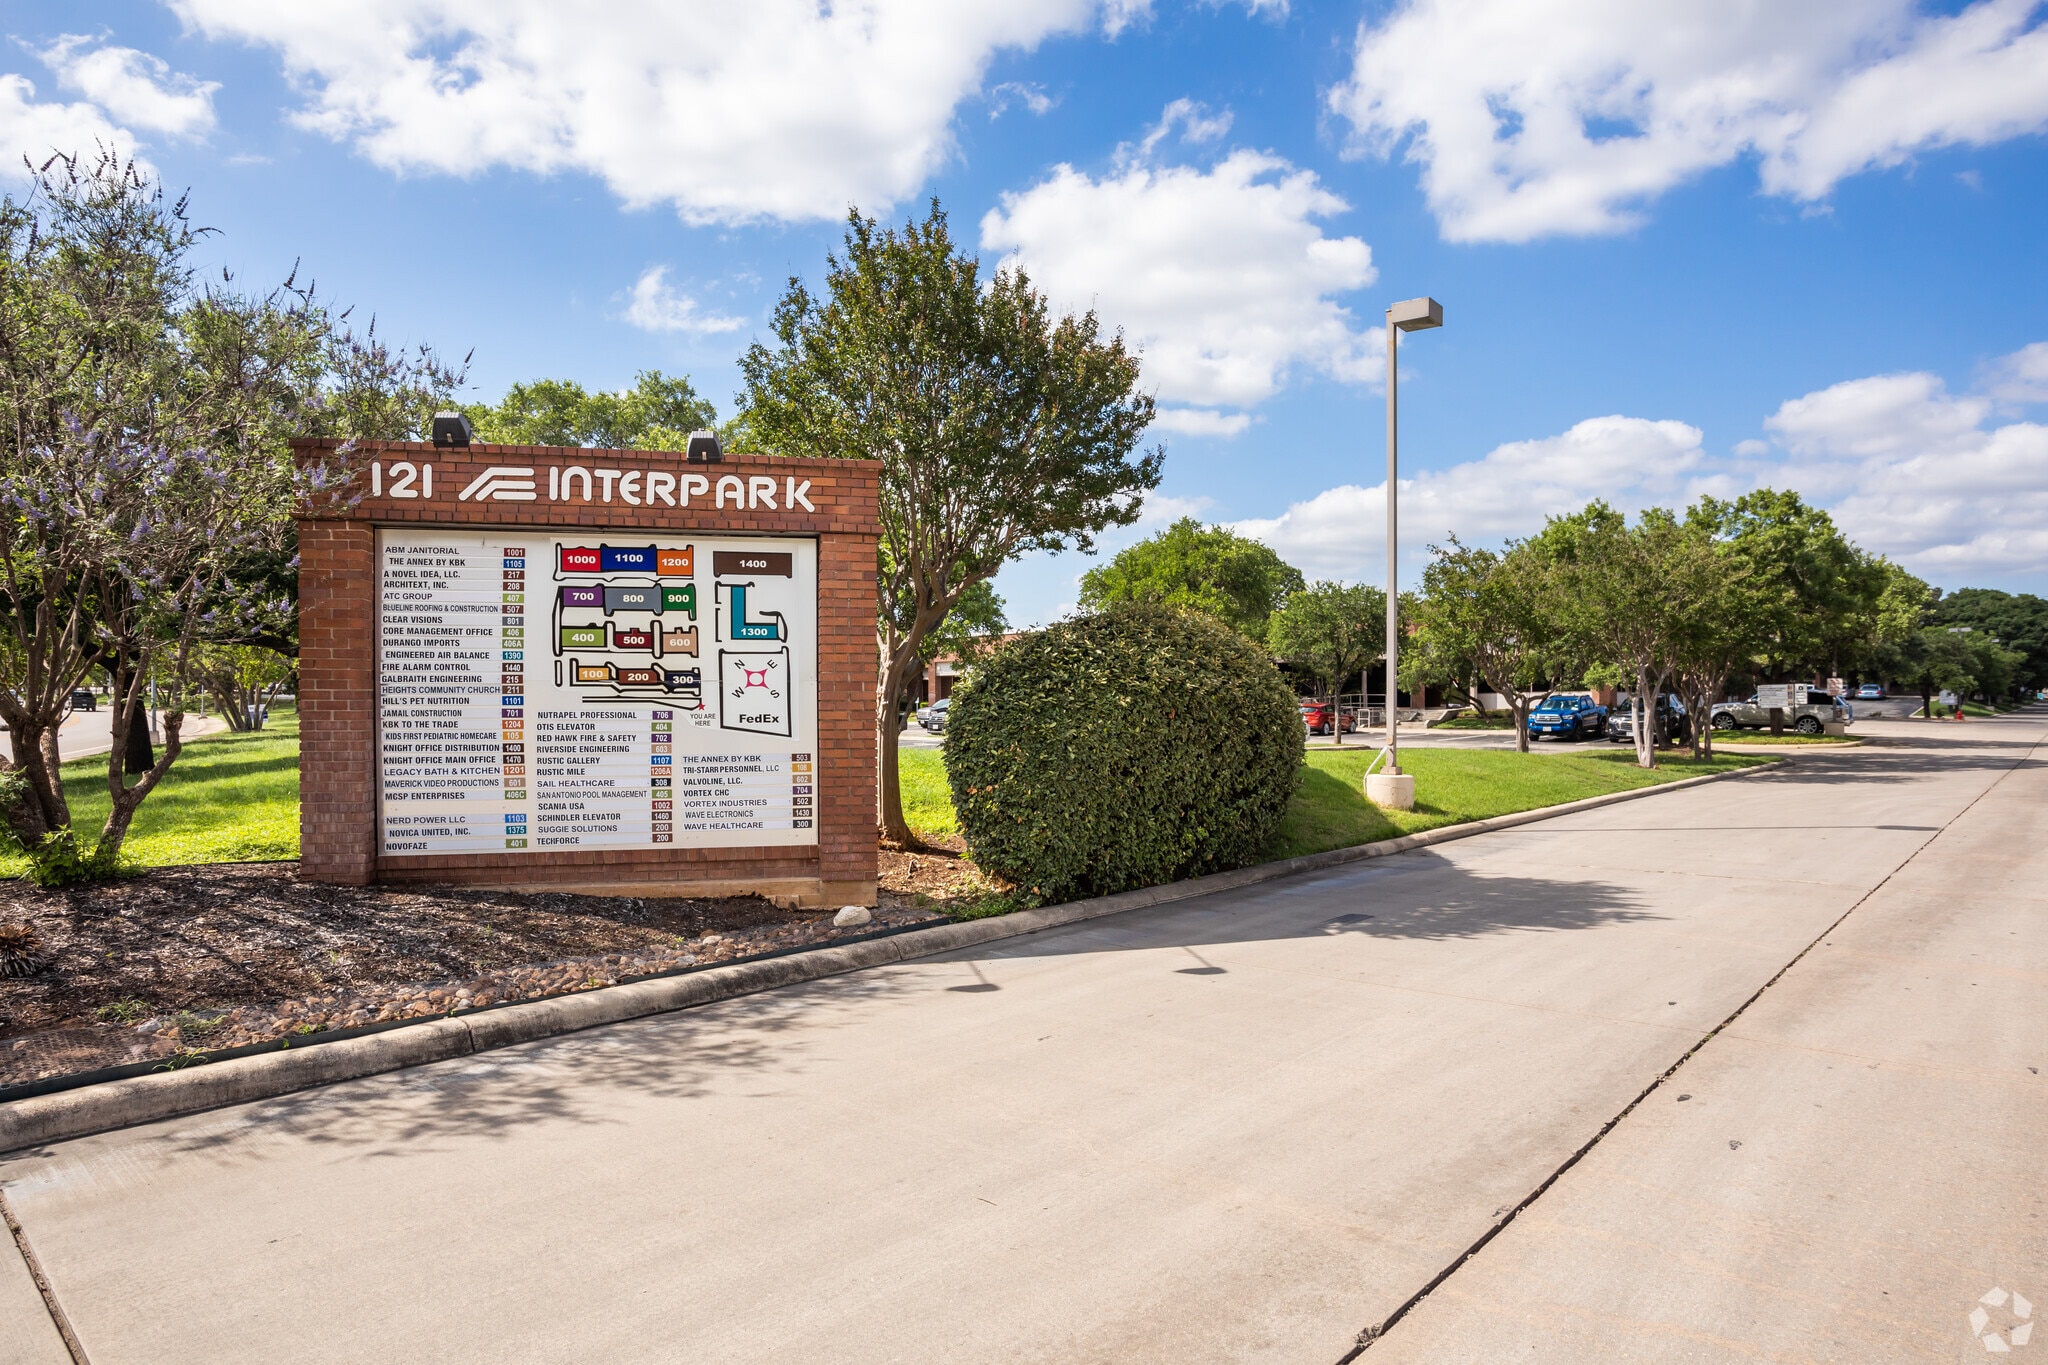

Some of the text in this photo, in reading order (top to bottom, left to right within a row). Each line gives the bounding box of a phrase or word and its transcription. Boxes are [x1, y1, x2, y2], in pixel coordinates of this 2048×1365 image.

[372, 462, 815, 512] 121 INTERPARK
[567, 555, 596, 564] 1000
[615, 554, 643, 562] 1100
[662, 558, 689, 566] 1200
[740, 560, 767, 568] 1400
[421, 571, 441, 579] IDEA,
[573, 593, 594, 601] 700
[623, 594, 644, 603] 800
[668, 594, 689, 603] 900
[741, 628, 767, 636] 1300
[572, 634, 594, 642] 400
[735, 660, 746, 670] N
[767, 660, 777, 669] E
[582, 670, 603, 678] 100
[628, 673, 649, 681] 200
[673, 676, 694, 684] 300
[732, 687, 745, 699] W
[770, 690, 779, 699] S
[739, 714, 779, 724] FedEx
[683, 778, 725, 786] VALVOLINE,
[707, 810, 753, 818] ELECTRONICS
[537, 837, 579, 845] TECHFORCE
